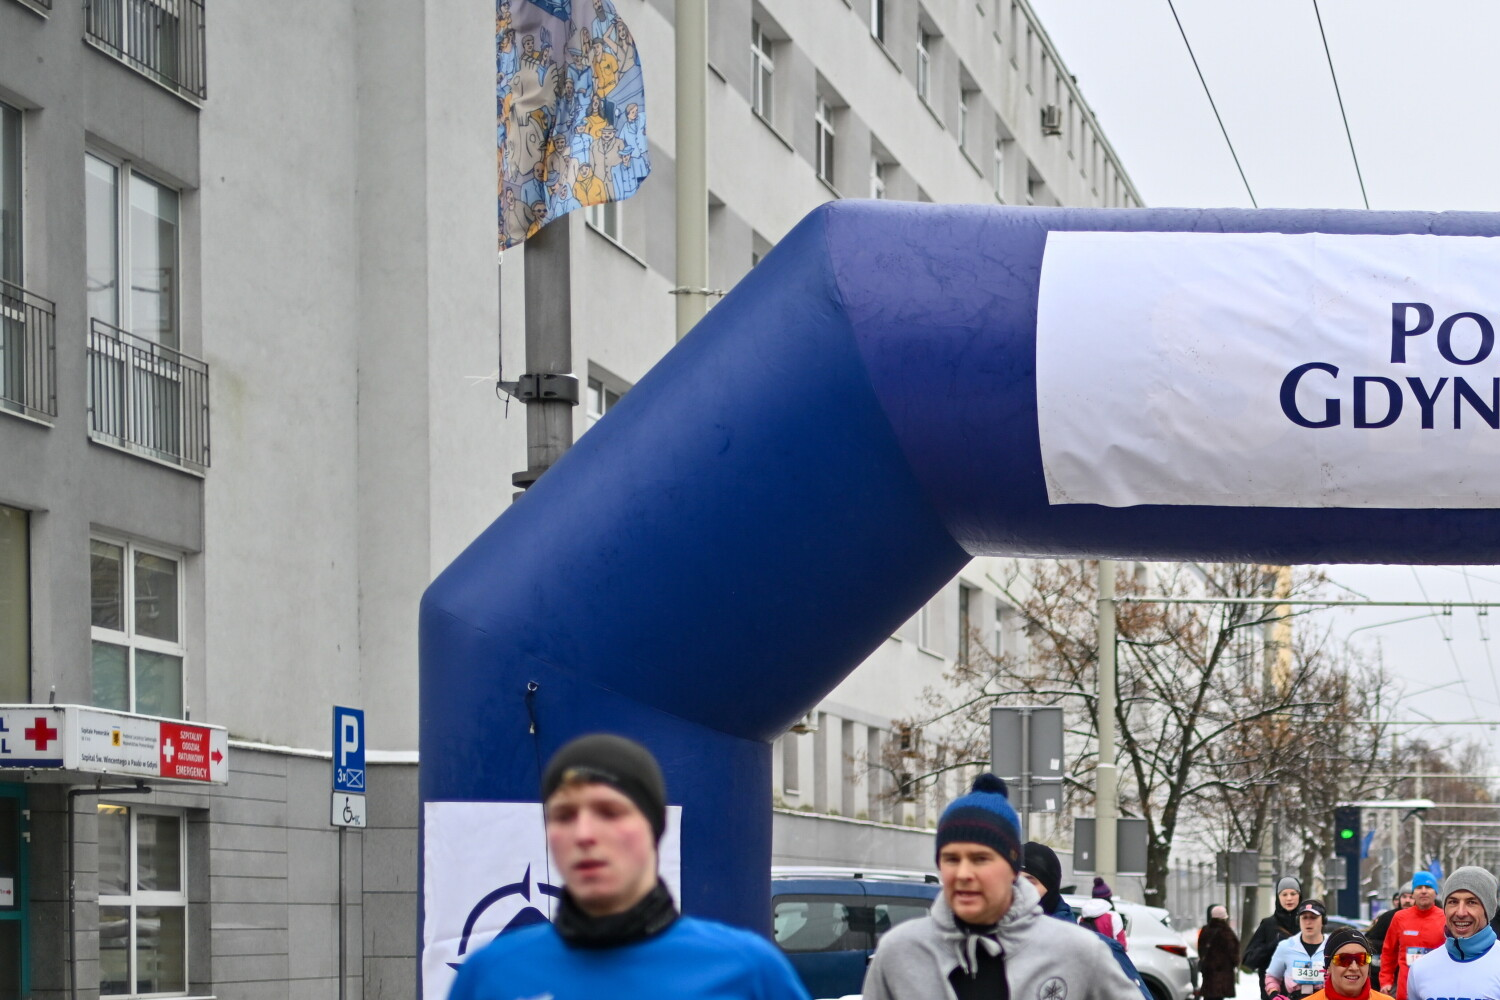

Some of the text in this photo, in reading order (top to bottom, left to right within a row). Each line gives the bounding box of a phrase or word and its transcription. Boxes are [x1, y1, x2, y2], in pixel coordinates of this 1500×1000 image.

[341, 714, 359, 767] P
[175, 764, 207, 778] EMERGENCY
[1297, 968, 1319, 977] 3430
